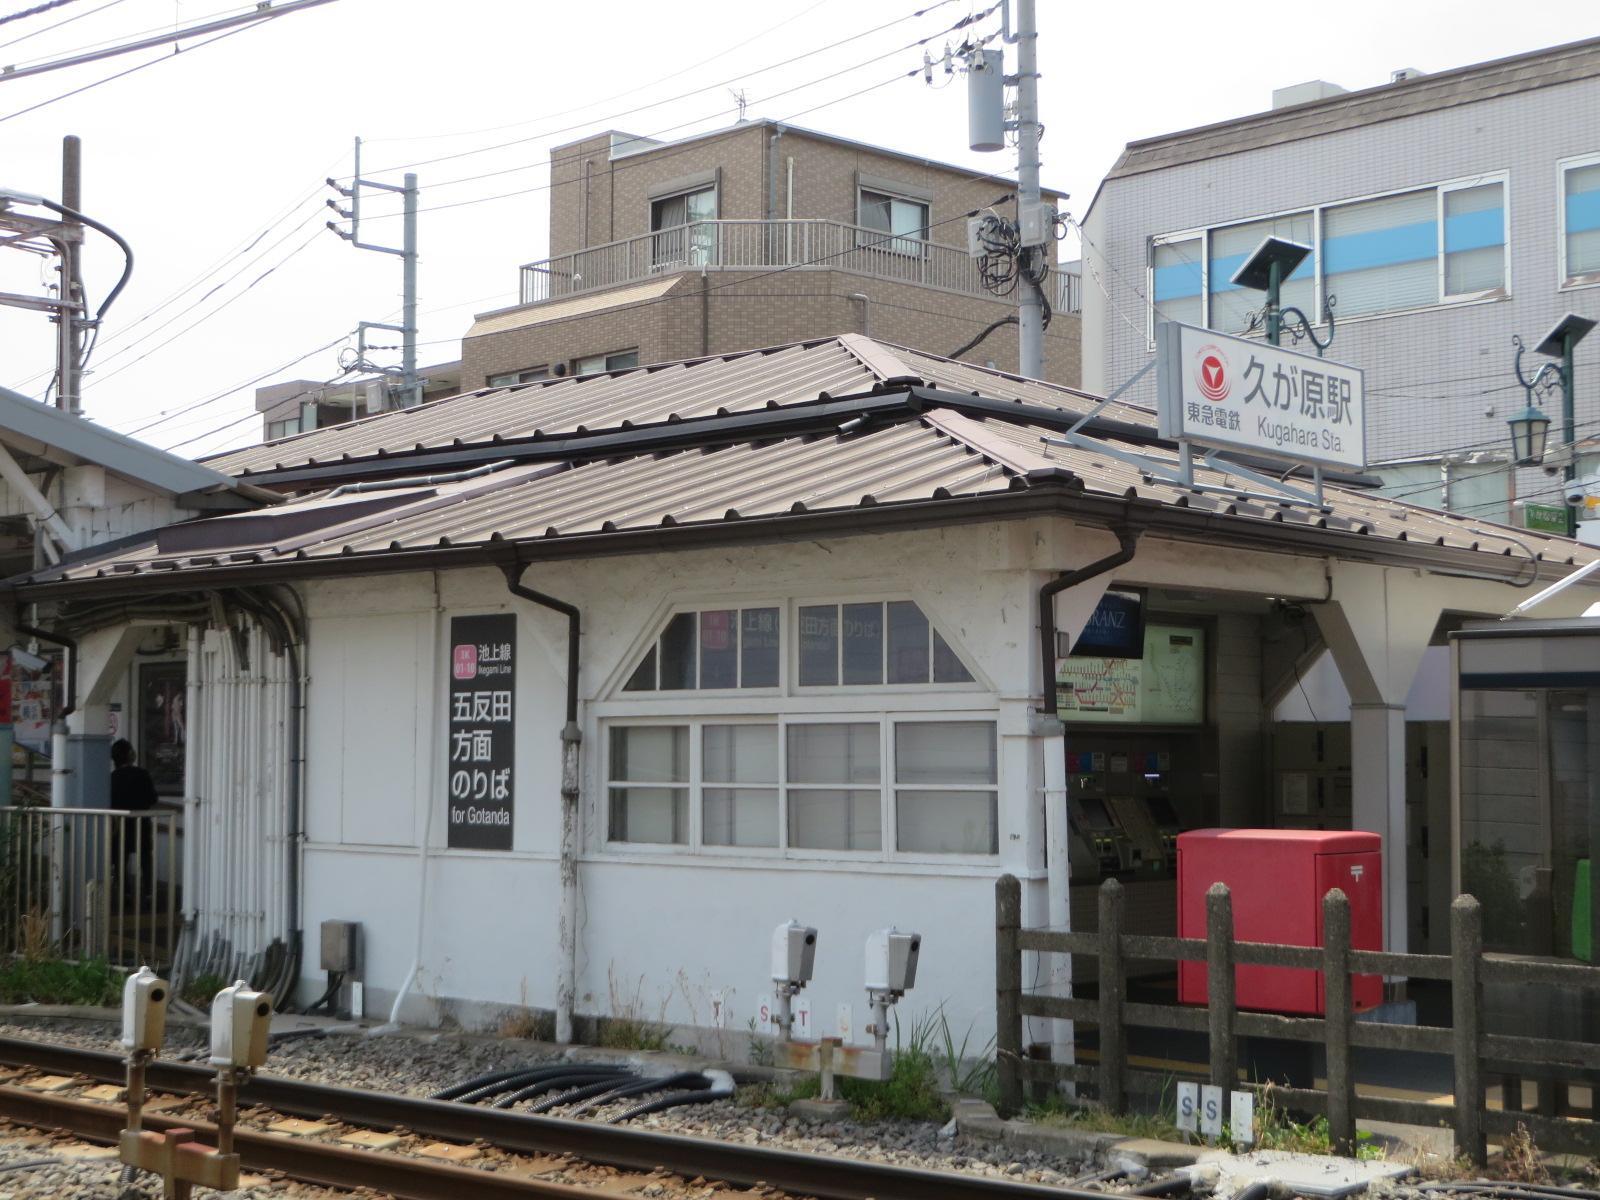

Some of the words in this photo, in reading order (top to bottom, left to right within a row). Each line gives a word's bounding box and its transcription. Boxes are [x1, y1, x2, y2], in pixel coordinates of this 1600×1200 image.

[1243, 355, 1352, 426] 久が原駅
[1187, 402, 1241, 432] 東急電鉄
[1257, 416, 1318, 449] Kugahara
[1322, 428, 1345, 453] Sta.
[1087, 609, 1126, 629] RANZ
[461, 650, 471, 660] IK
[478, 643, 511, 661] 池上線
[478, 664, 499, 677] Ikegami
[500, 663, 512, 674] Line
[453, 691, 511, 722] 五反田
[453, 729, 493, 762] 方面
[452, 768, 511, 799] のりば
[452, 805, 465, 824] for
[467, 806, 510, 825] Gotanda
[760, 1005, 769, 1022] S
[799, 1010, 808, 1027] T
[1181, 1096, 1192, 1117] S
[1206, 1100, 1217, 1121] S
